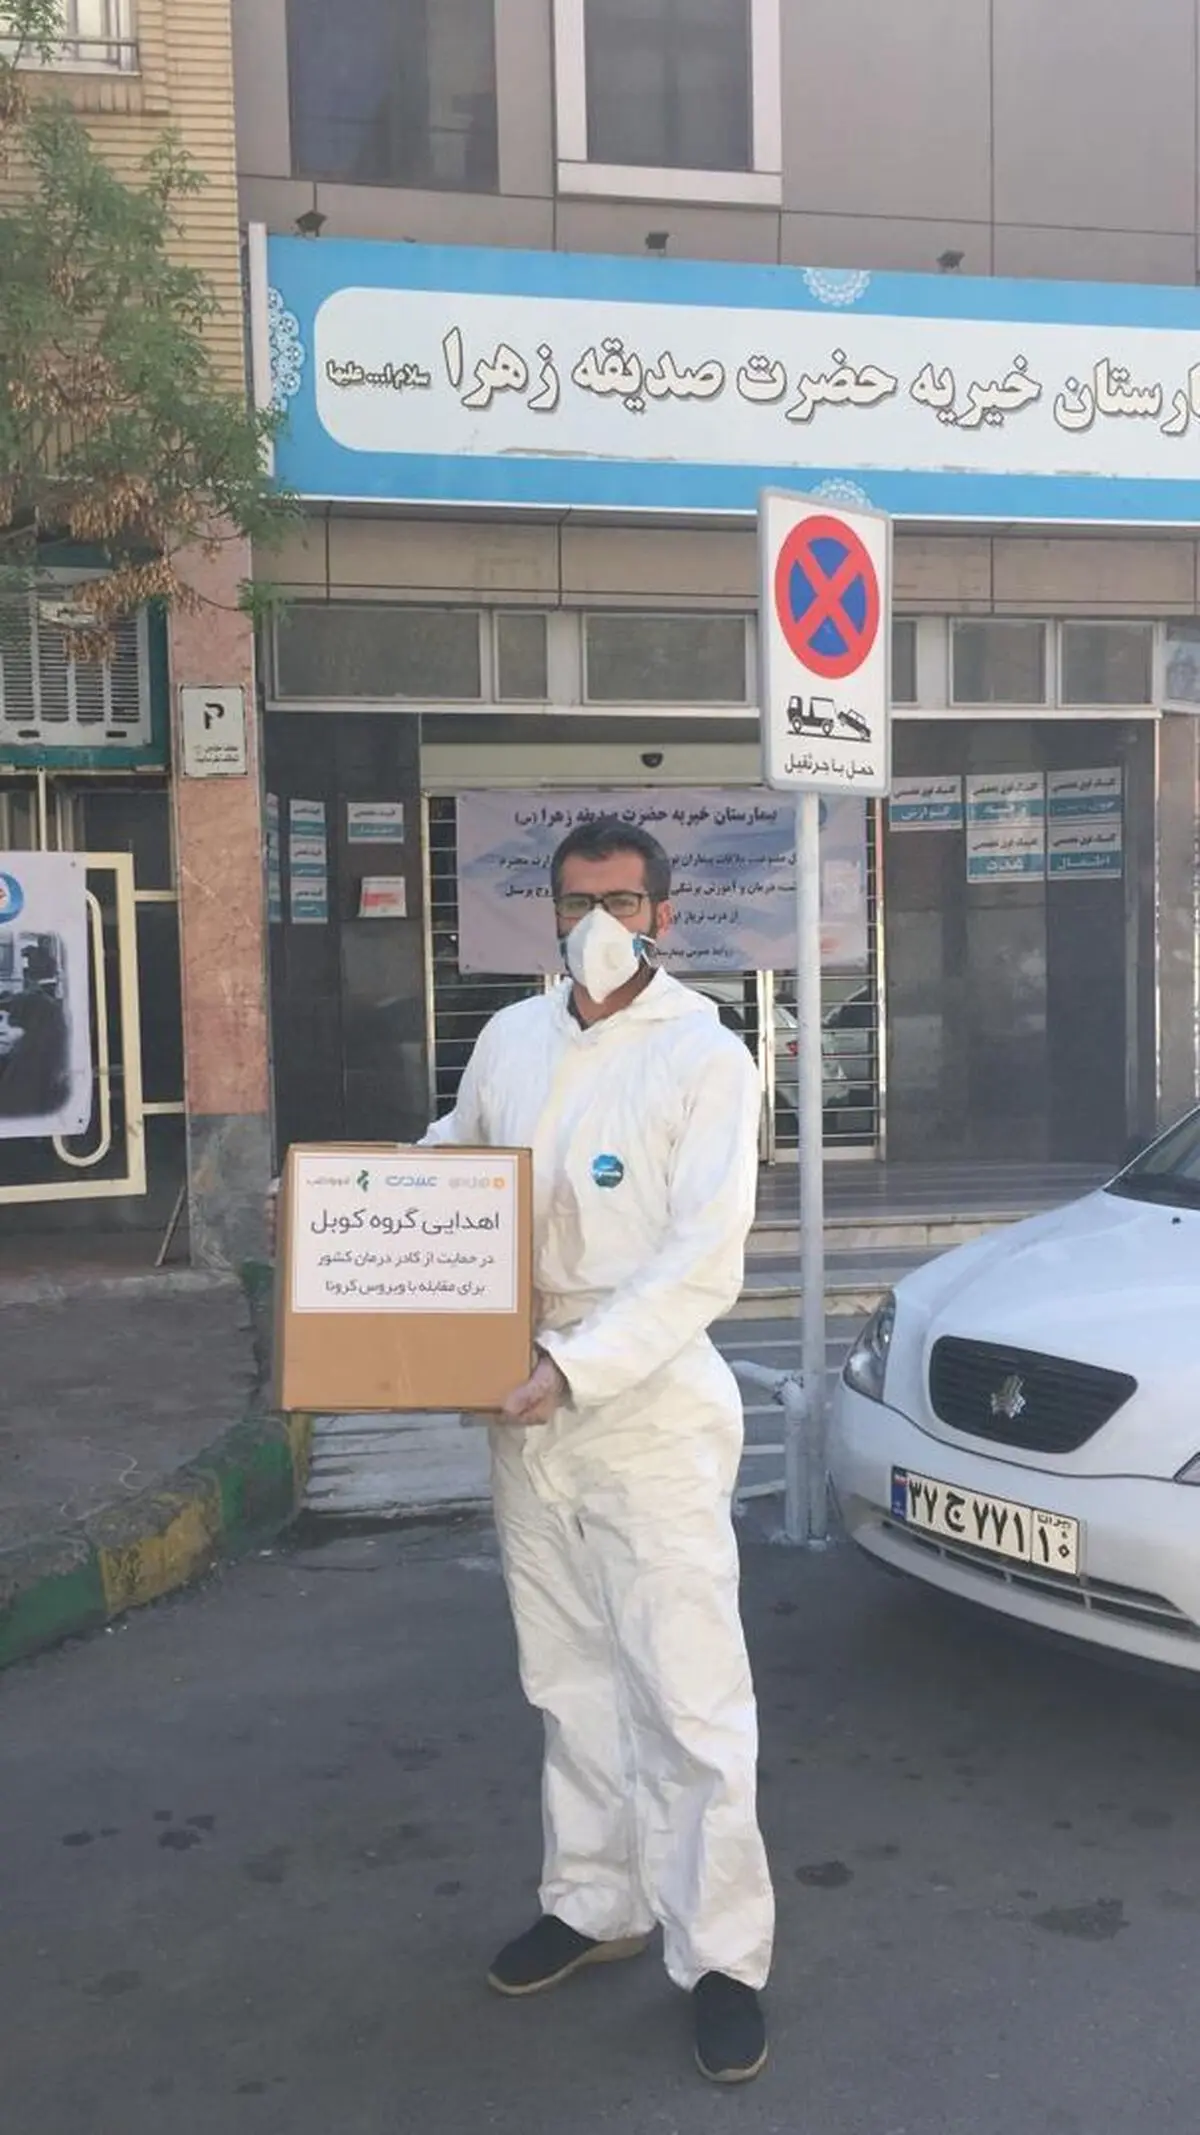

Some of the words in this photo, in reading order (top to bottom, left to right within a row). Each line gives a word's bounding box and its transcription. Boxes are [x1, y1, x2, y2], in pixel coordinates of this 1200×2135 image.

[326, 358, 365, 387] علیها
[393, 363, 432, 390] سلام
[442, 326, 561, 411] زهرا
[571, 337, 725, 413] صدیقه
[737, 348, 898, 422] حضرت
[909, 354, 1042, 430] خیریه
[1053, 357, 1200, 436] ارستان
[784, 752, 829, 775] جرثقیل
[831, 759, 844, 776] با
[847, 760, 874, 779] حمل
[541, 807, 573, 828] زهرا
[622, 806, 668, 827] حضرت
[672, 806, 710, 826] خیریه
[714, 806, 778, 826] بیمارستان
[310, 1208, 366, 1235] کوبل
[369, 1206, 419, 1235] گروه
[422, 1210, 500, 1235] اهدایی
[317, 1250, 352, 1267] کشور
[354, 1252, 392, 1268] درمان
[395, 1250, 420, 1268] کادر
[424, 1252, 433, 1267] از
[436, 1252, 477, 1267] حمایت
[479, 1254, 495, 1268] در
[325, 1279, 358, 1296] کرونا
[358, 1281, 405, 1296] ویروس
[407, 1280, 417, 1294] با
[419, 1279, 455, 1294] مقابله
[456, 1281, 485, 1296] برای
[945, 1491, 966, 1533] ج
[973, 1500, 1024, 1553] ۷۷۱
